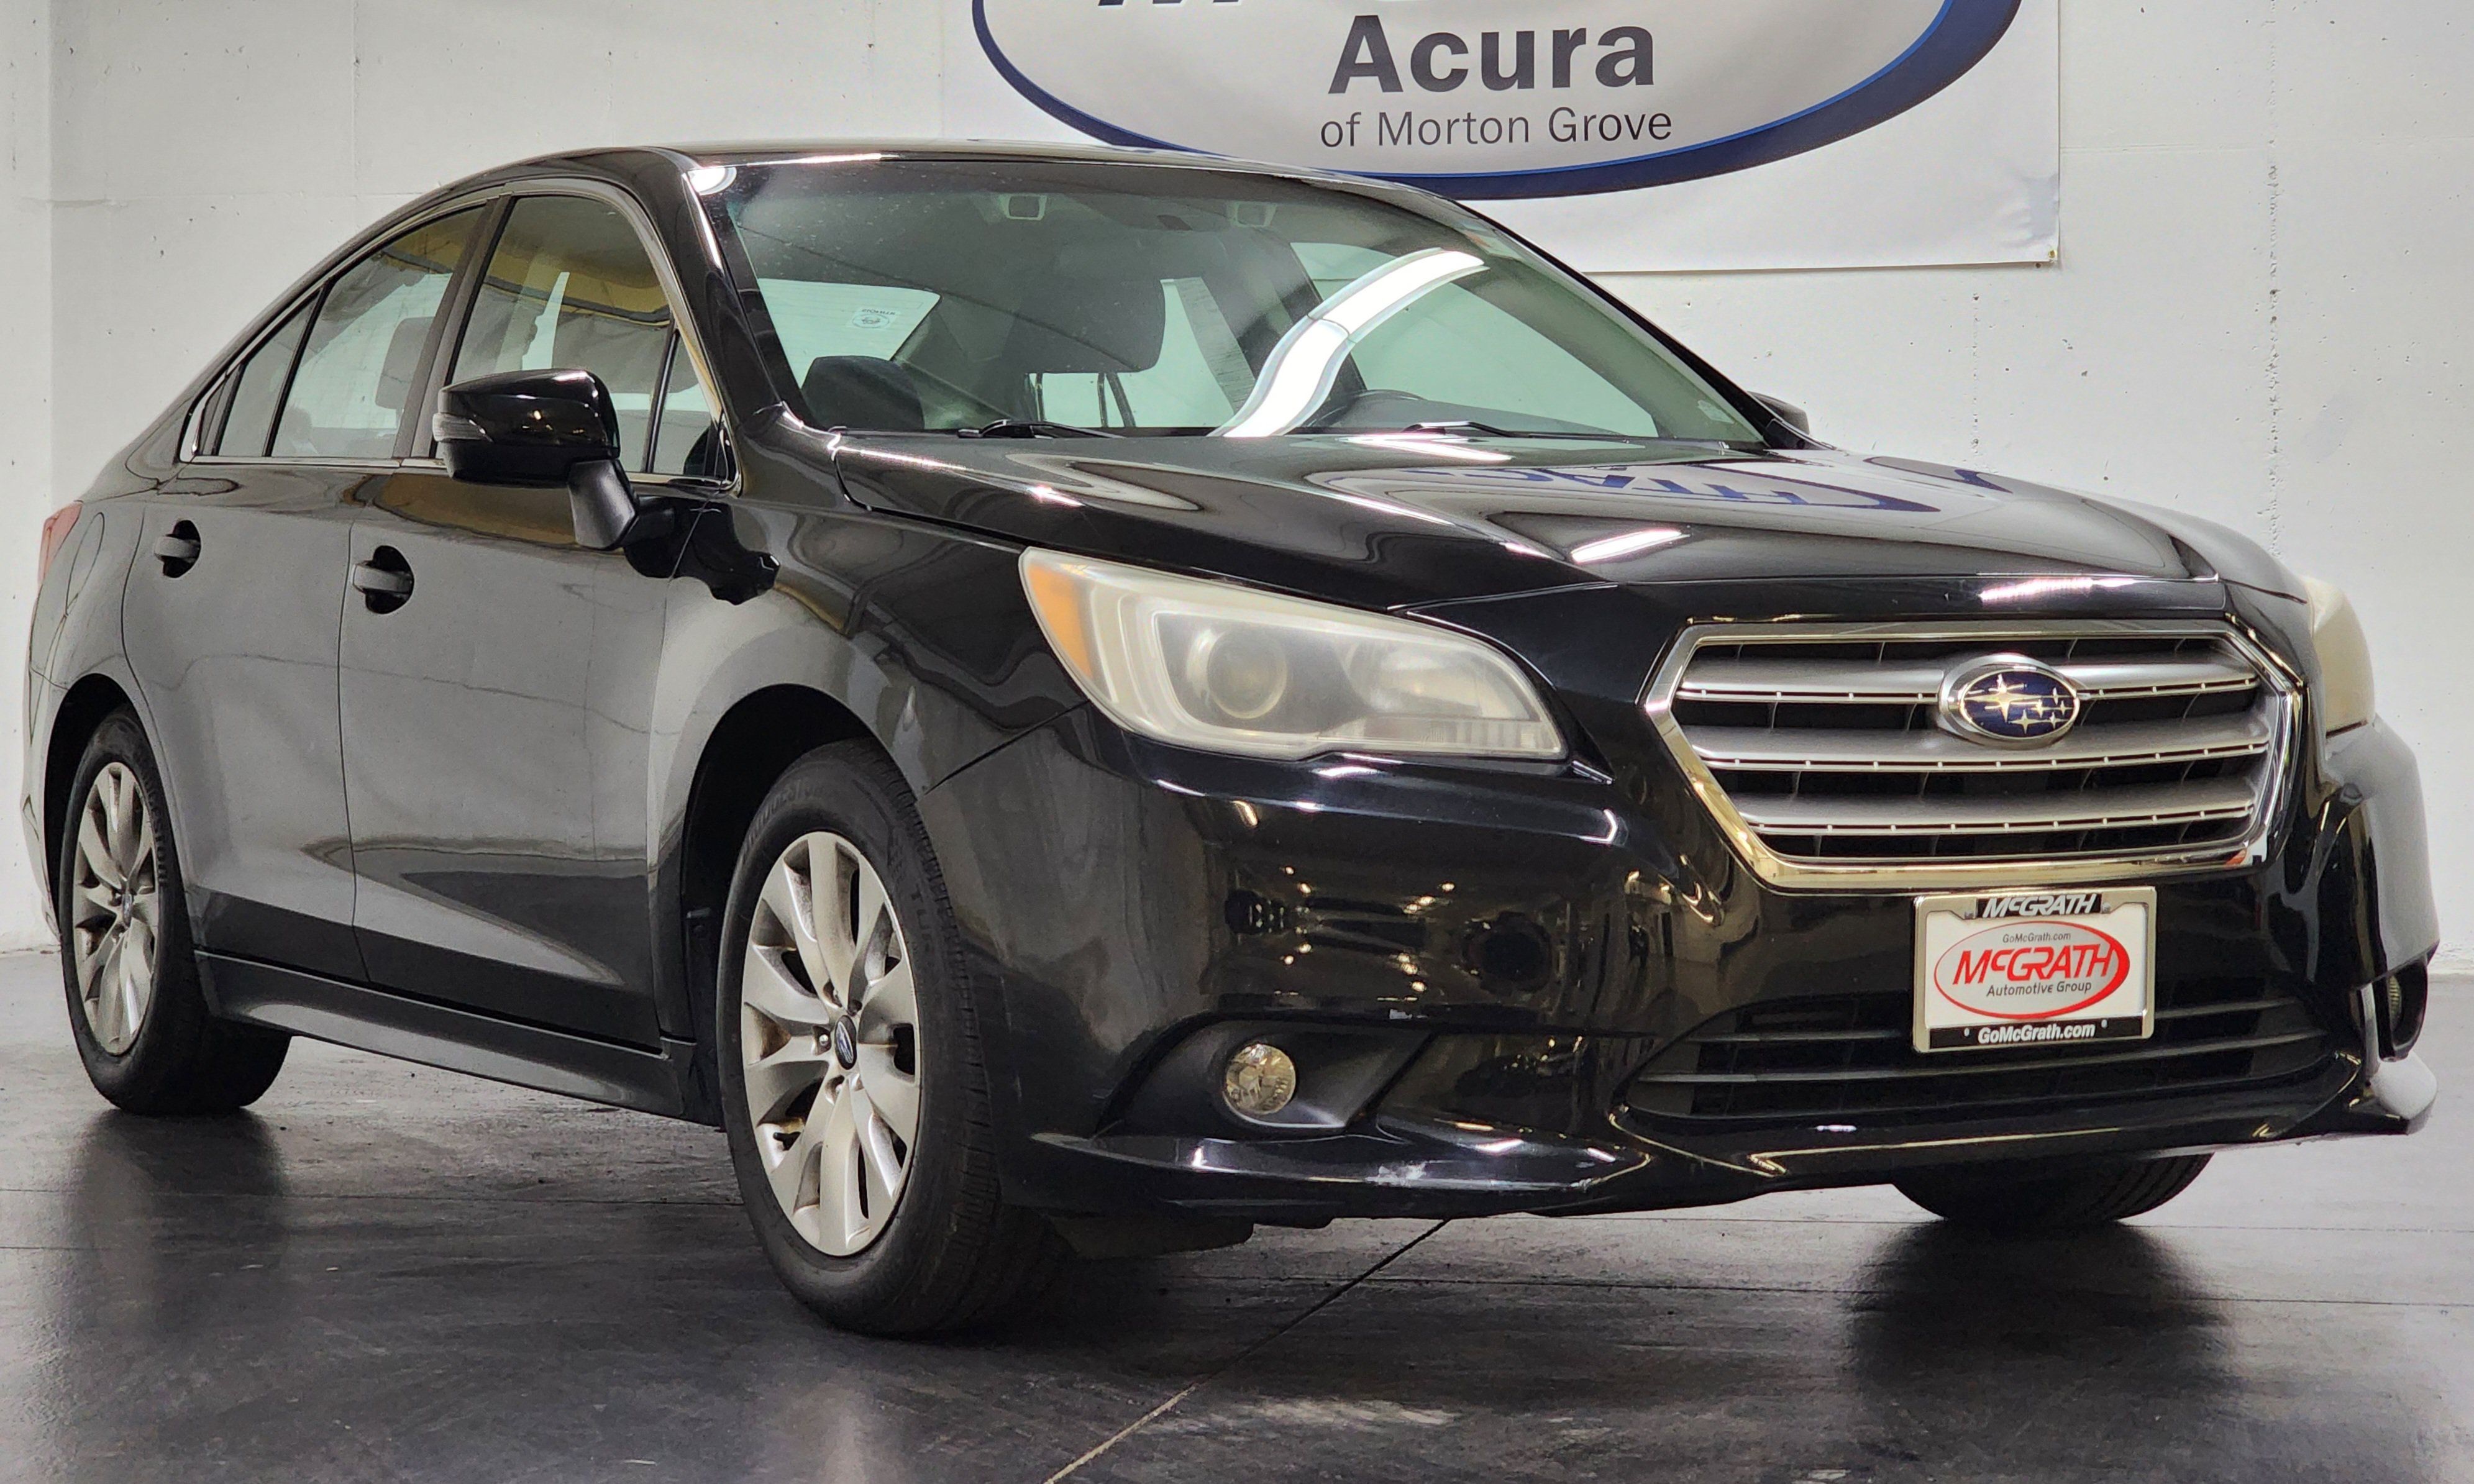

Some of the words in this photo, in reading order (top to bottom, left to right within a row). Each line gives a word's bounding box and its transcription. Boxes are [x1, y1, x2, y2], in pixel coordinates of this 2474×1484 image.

[1328, 14, 1655, 94] Acura
[1321, 111, 1361, 148] of
[1378, 111, 1529, 147] Morton
[1548, 106, 1672, 143] Grove
[1982, 893, 2097, 918] McGRATH
[2002, 932, 2071, 944] GoMcGrath.com
[1953, 944, 2112, 985] McGRATH
[1986, 982, 2053, 997] Automotive
[2056, 981, 2092, 994] Group
[1978, 1023, 2095, 1044] GoMcGrath.com
